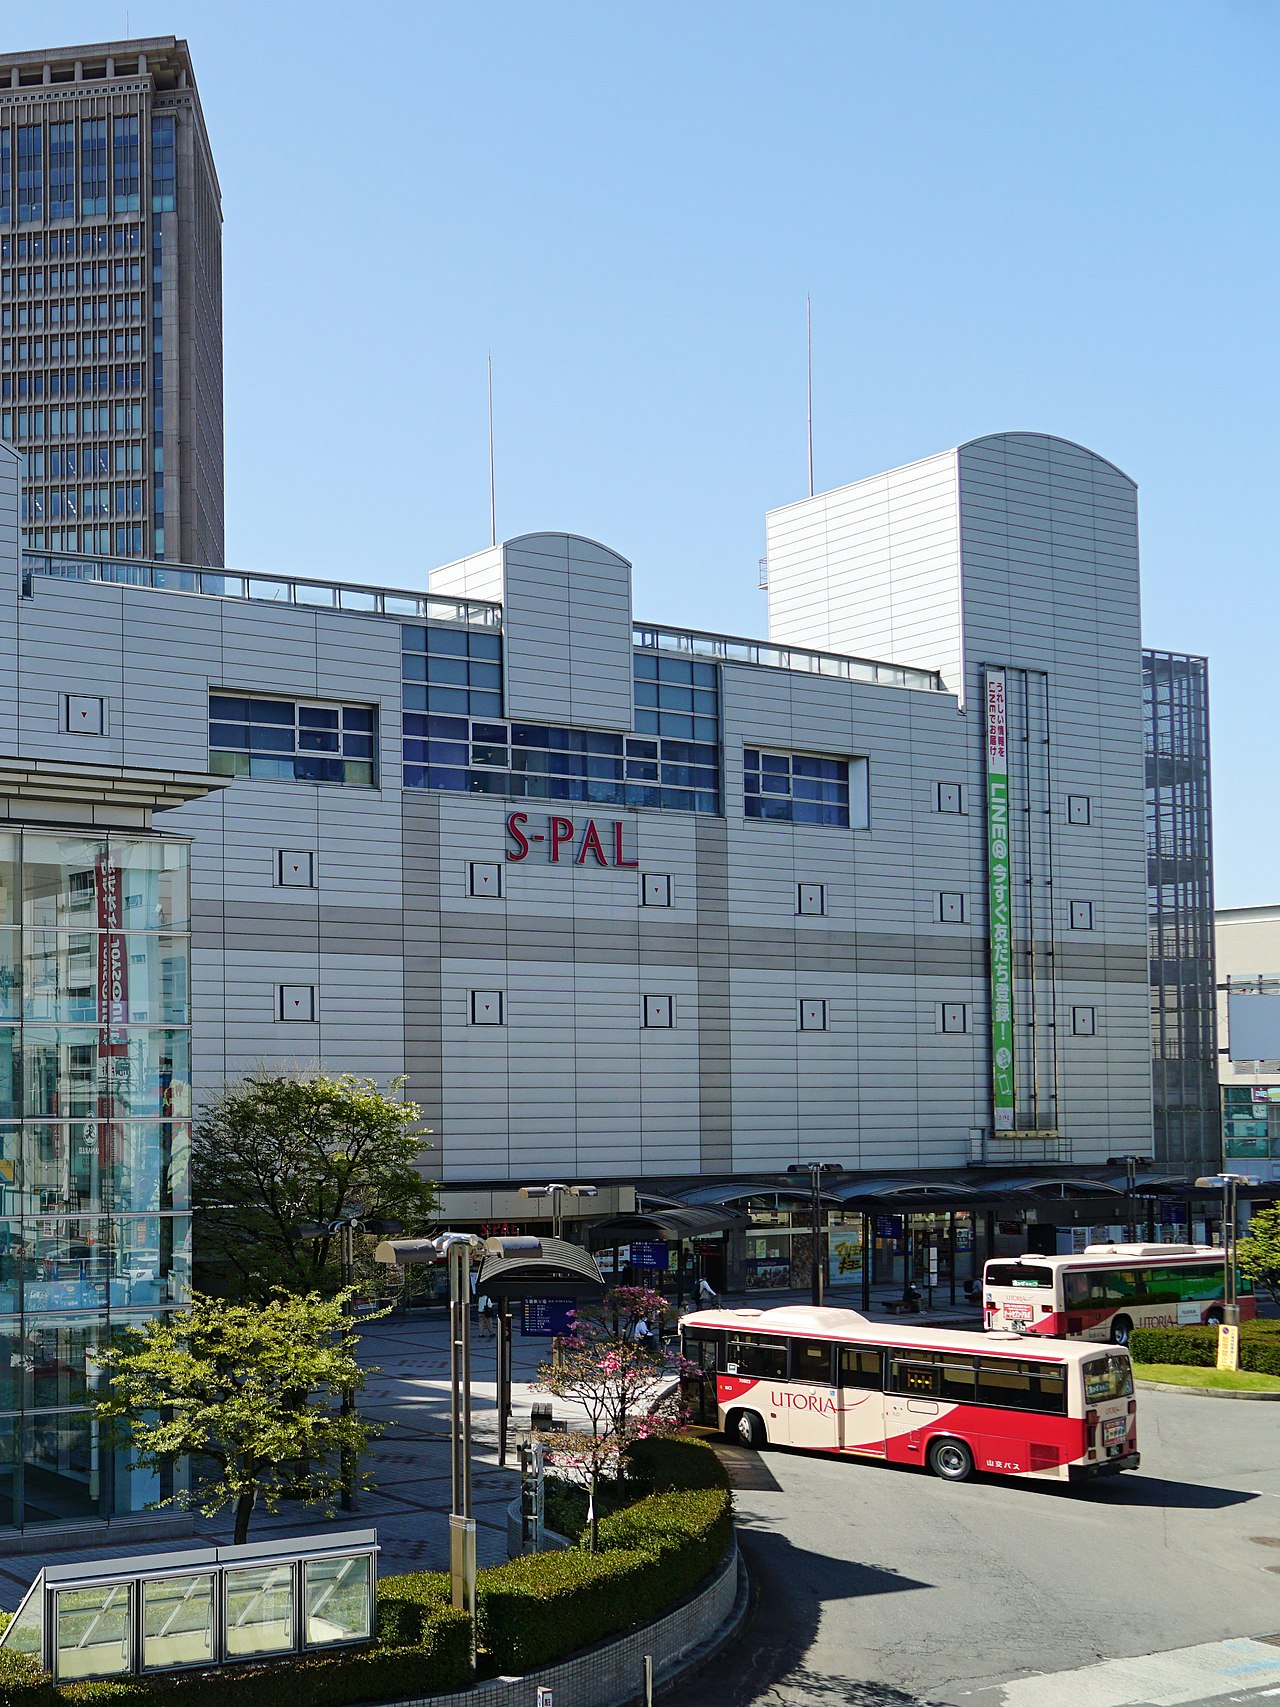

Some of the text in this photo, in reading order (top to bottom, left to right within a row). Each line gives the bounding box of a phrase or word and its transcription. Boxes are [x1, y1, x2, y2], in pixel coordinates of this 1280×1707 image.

[995, 681, 1005, 758] うれしい情報を
[506, 811, 640, 868] S-PAL
[991, 782, 1008, 859] LINE@
[1139, 1315, 1173, 1328] UTORIA
[771, 1391, 837, 1416] UTORIA
[986, 1459, 1021, 1471] 山交バス
